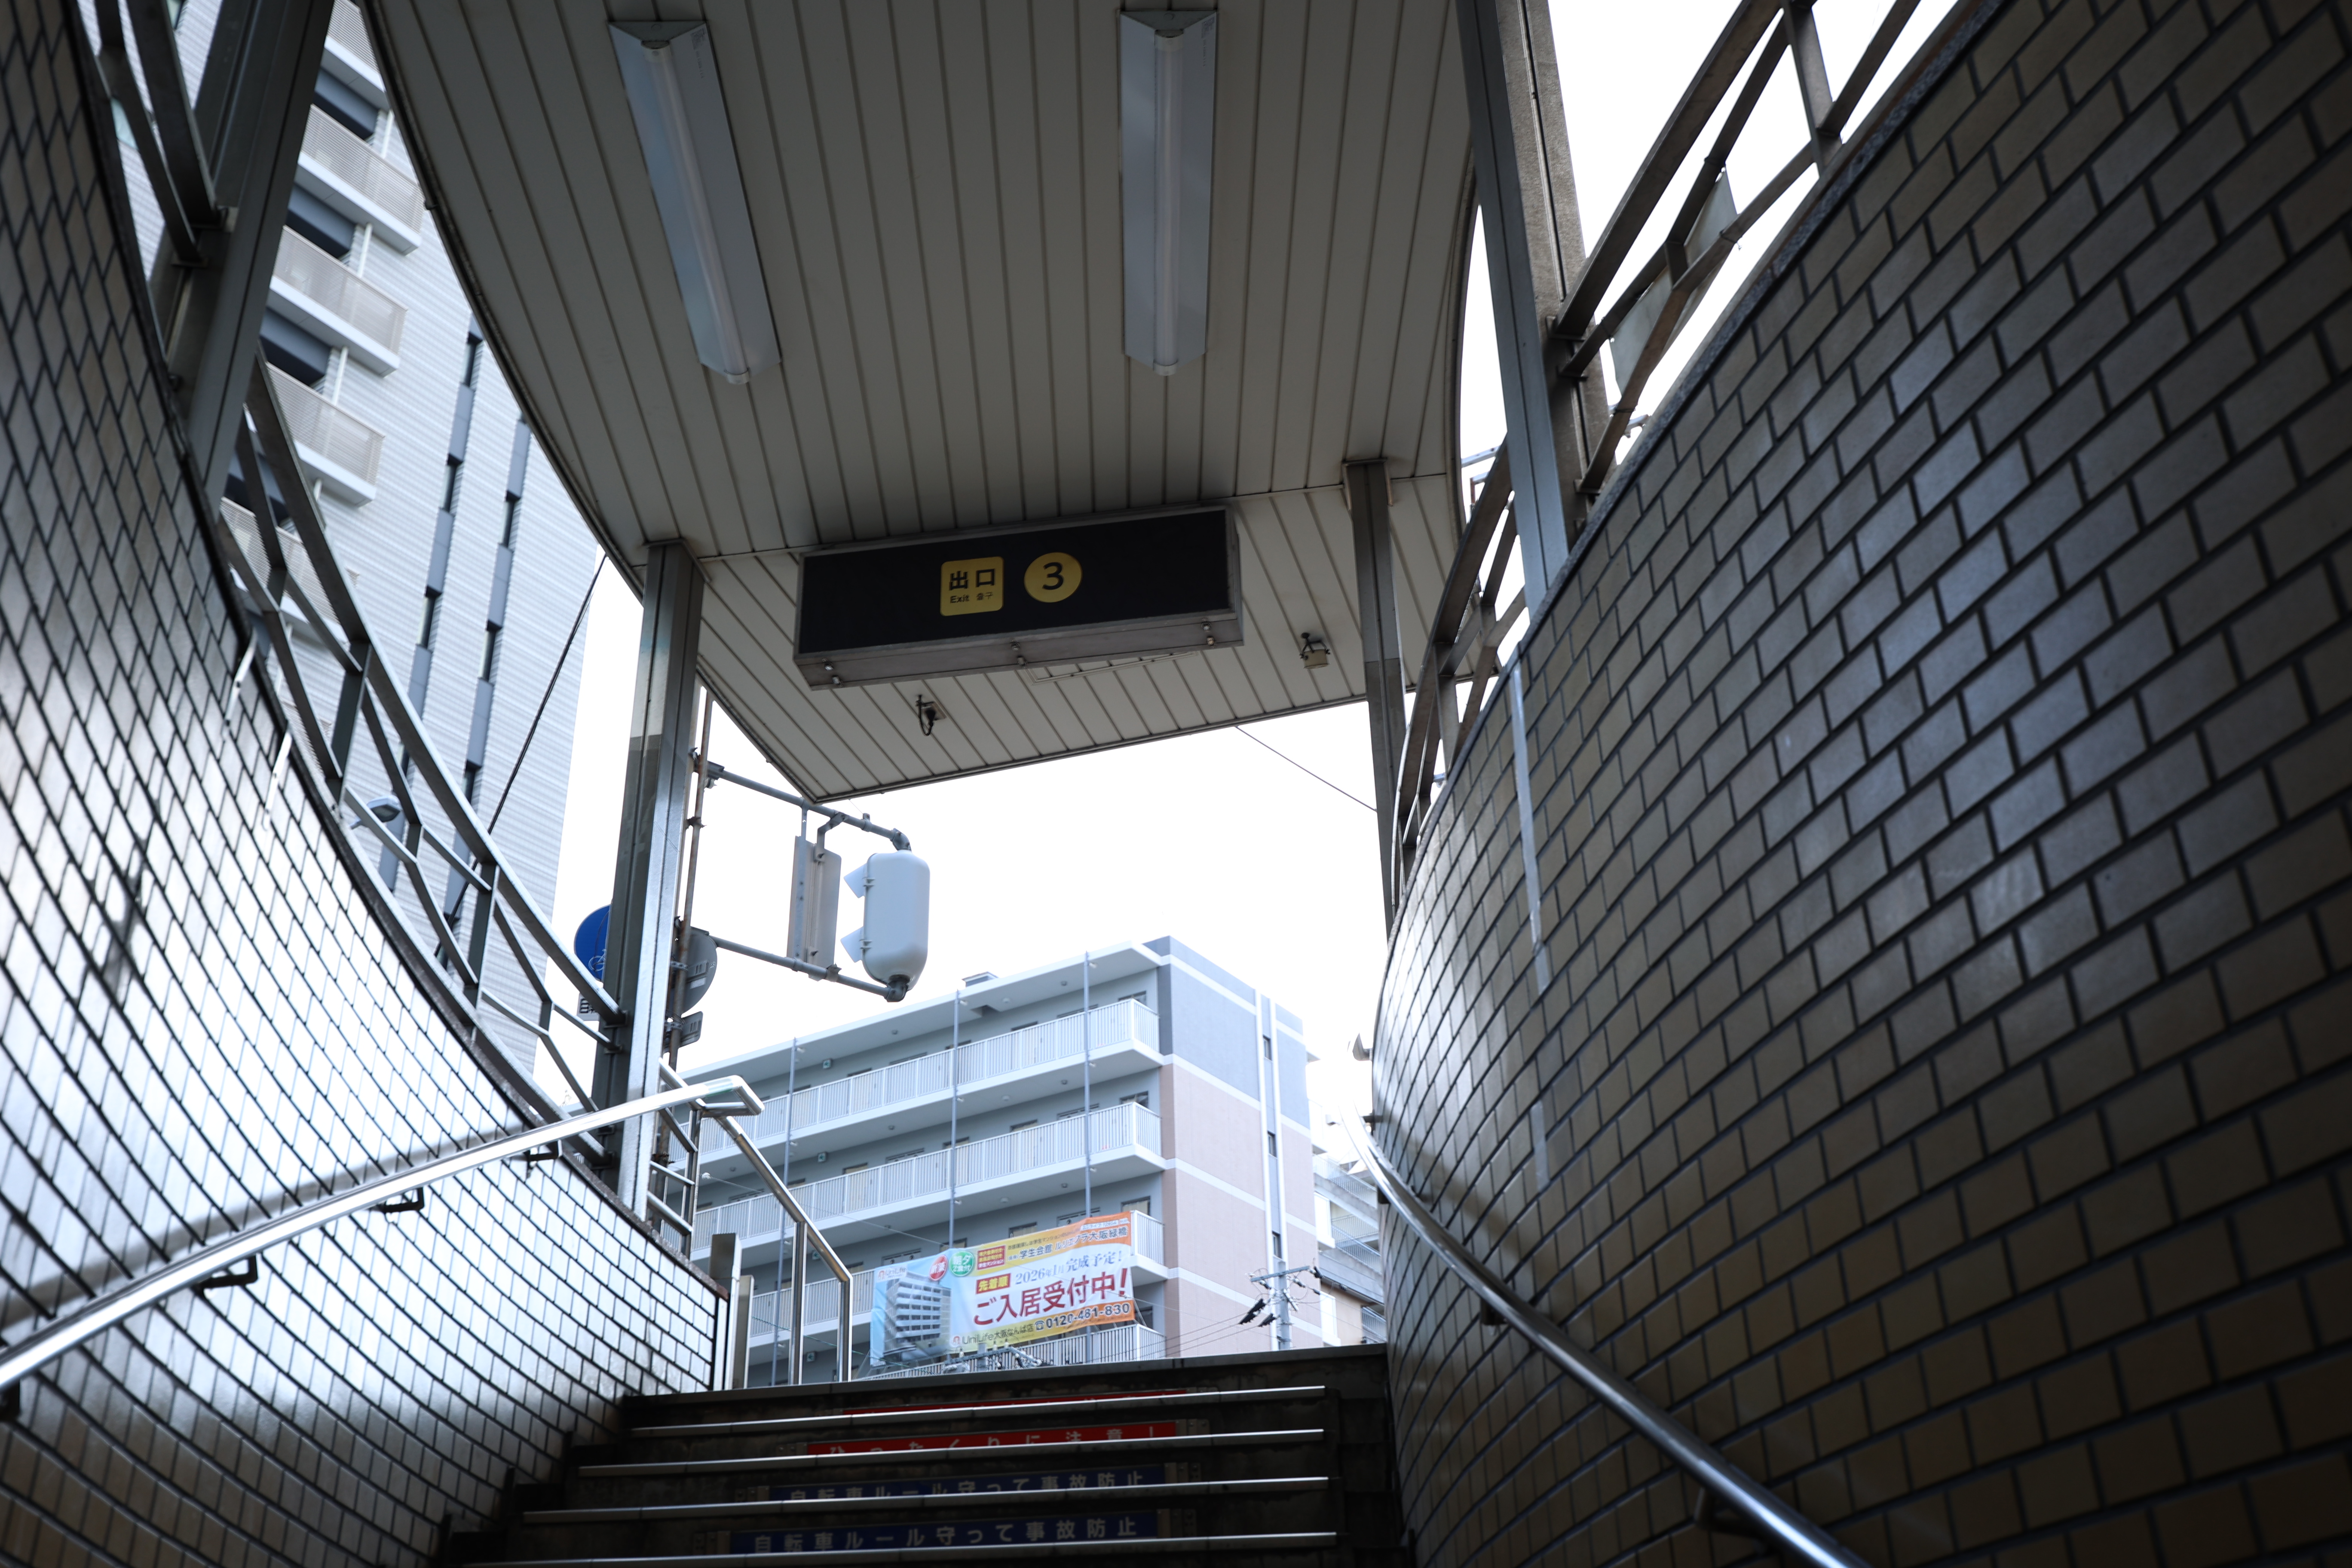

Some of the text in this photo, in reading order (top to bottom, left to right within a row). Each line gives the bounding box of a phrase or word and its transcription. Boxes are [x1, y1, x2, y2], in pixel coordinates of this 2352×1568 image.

[949, 562, 1064, 591] 出口 3
[950, 594, 970, 603] Exit
[976, 591, 994, 601] 출구
[978, 1275, 1008, 1292] 先着順
[974, 1268, 1127, 1326] ご入居受付中！
[1046, 1303, 1130, 1328] 0120-481-830
[754, 1516, 1136, 1553] 自転車ルール守って事故防止
